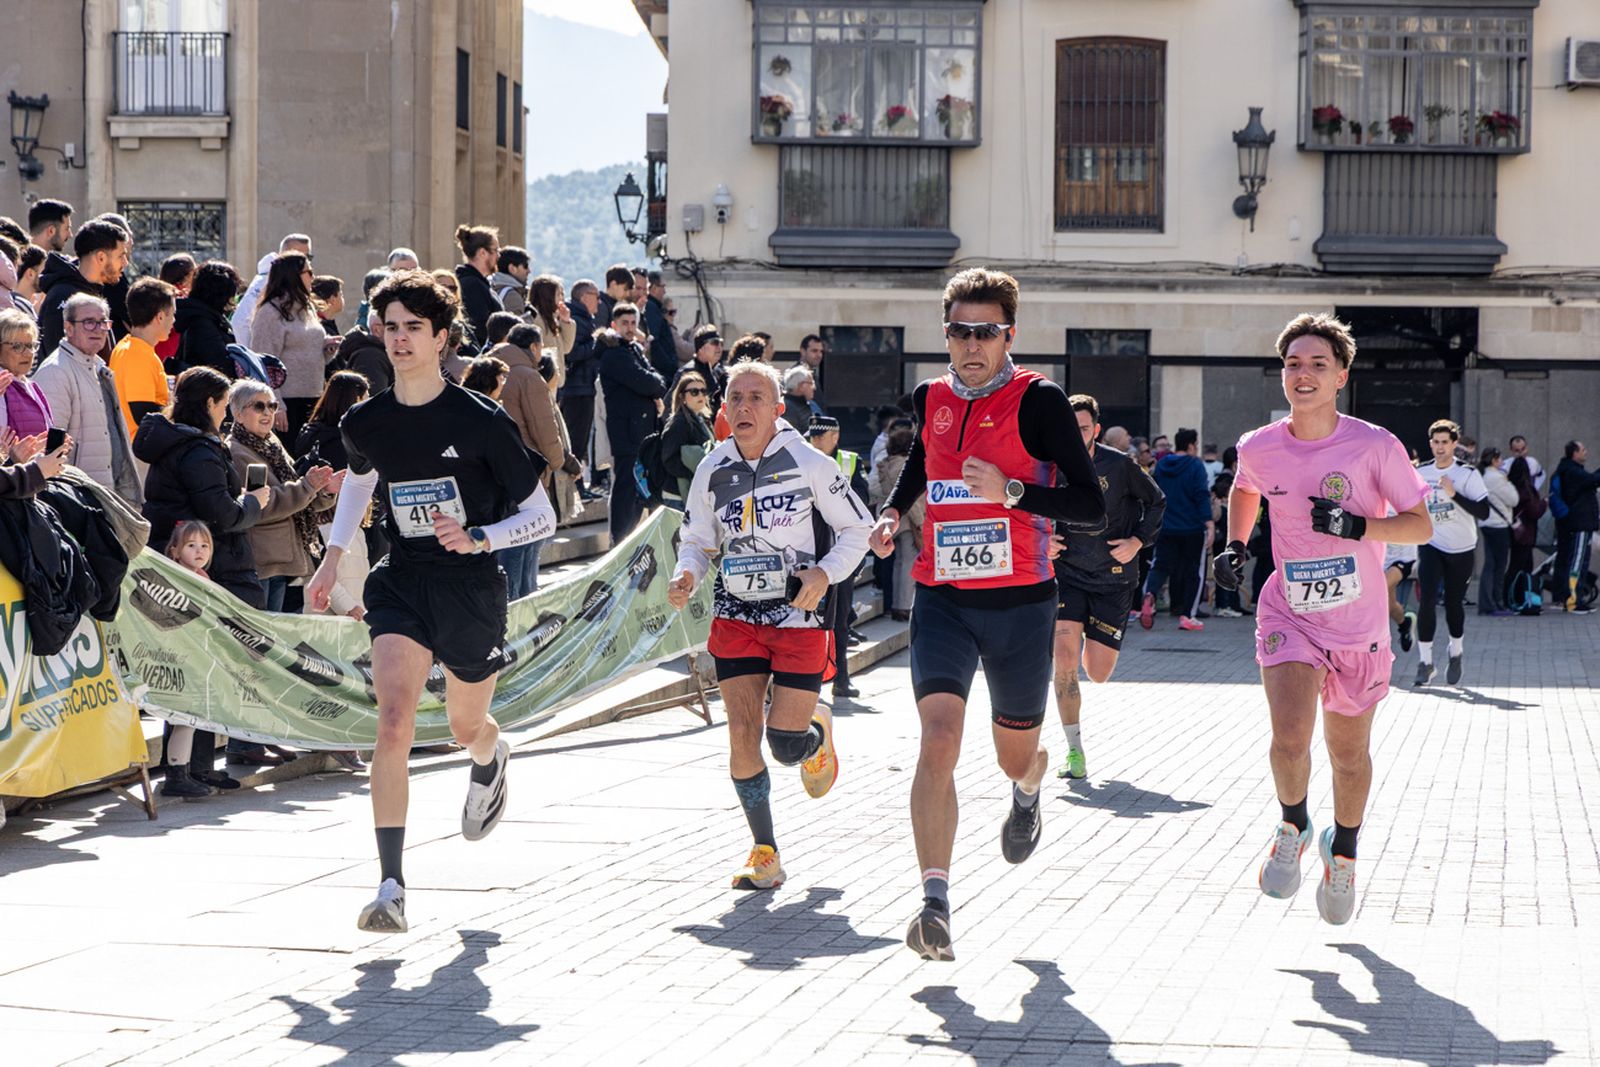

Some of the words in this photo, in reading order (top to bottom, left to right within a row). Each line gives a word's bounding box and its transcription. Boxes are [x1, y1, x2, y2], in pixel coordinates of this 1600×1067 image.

[951, 545, 993, 567] 466
[744, 573, 767, 590] 75
[1311, 567, 1336, 579] MUERTE
[1301, 578, 1343, 601] 792
